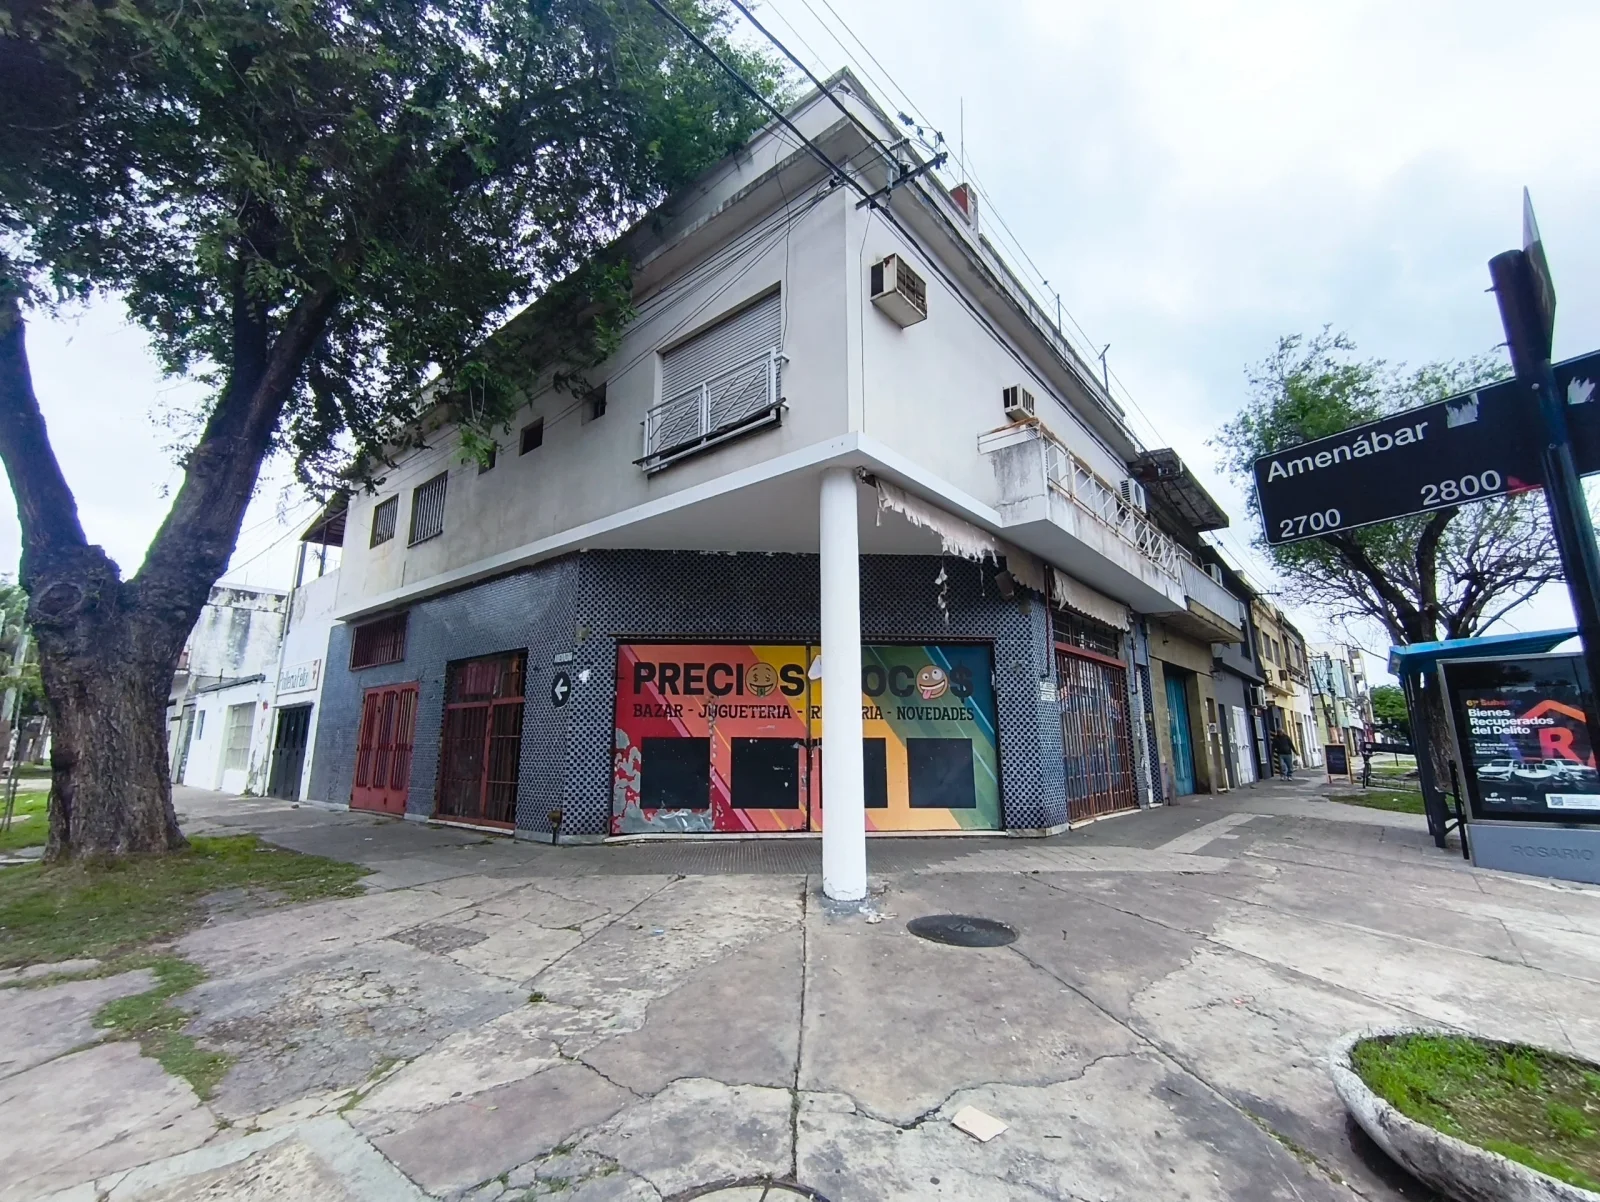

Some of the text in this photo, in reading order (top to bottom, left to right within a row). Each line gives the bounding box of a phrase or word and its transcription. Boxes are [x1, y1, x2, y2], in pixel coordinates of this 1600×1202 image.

[1267, 421, 1429, 483] Amenábar
[1279, 469, 1502, 538] 2700 2800
[633, 703, 684, 719] BAZAR
[698, 704, 792, 719] JUGUETERIA
[896, 706, 975, 721] NOVEDADES
[1467, 708, 1511, 717] Bienes
[1469, 716, 1555, 728] Recuperados
[1471, 725, 1531, 735] del Delito
[1510, 845, 1595, 861] ROSARIO
